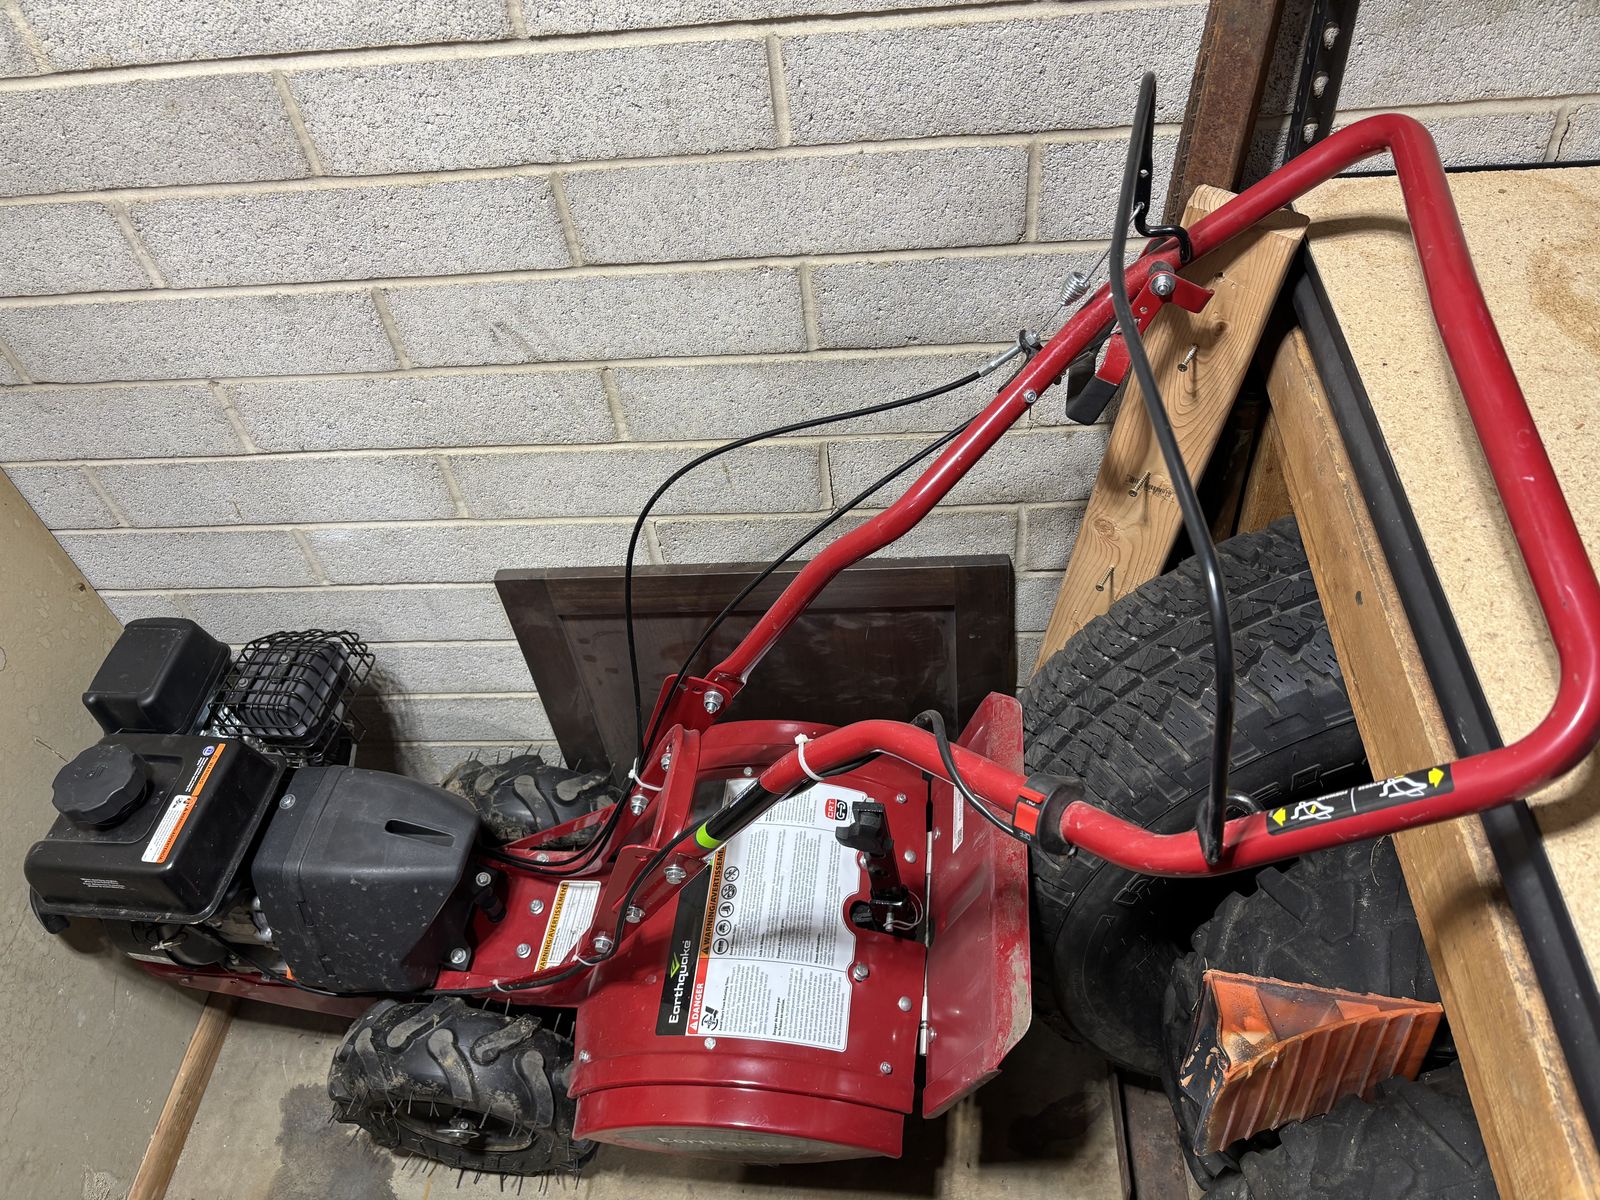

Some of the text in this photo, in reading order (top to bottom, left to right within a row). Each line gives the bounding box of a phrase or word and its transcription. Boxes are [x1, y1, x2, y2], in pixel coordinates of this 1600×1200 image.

[827, 800, 835, 818] CRT
[705, 848, 725, 948] WARNING/AVERTISSEM
[669, 940, 691, 1024] Earthquake
[691, 983, 704, 1020] DANGER
